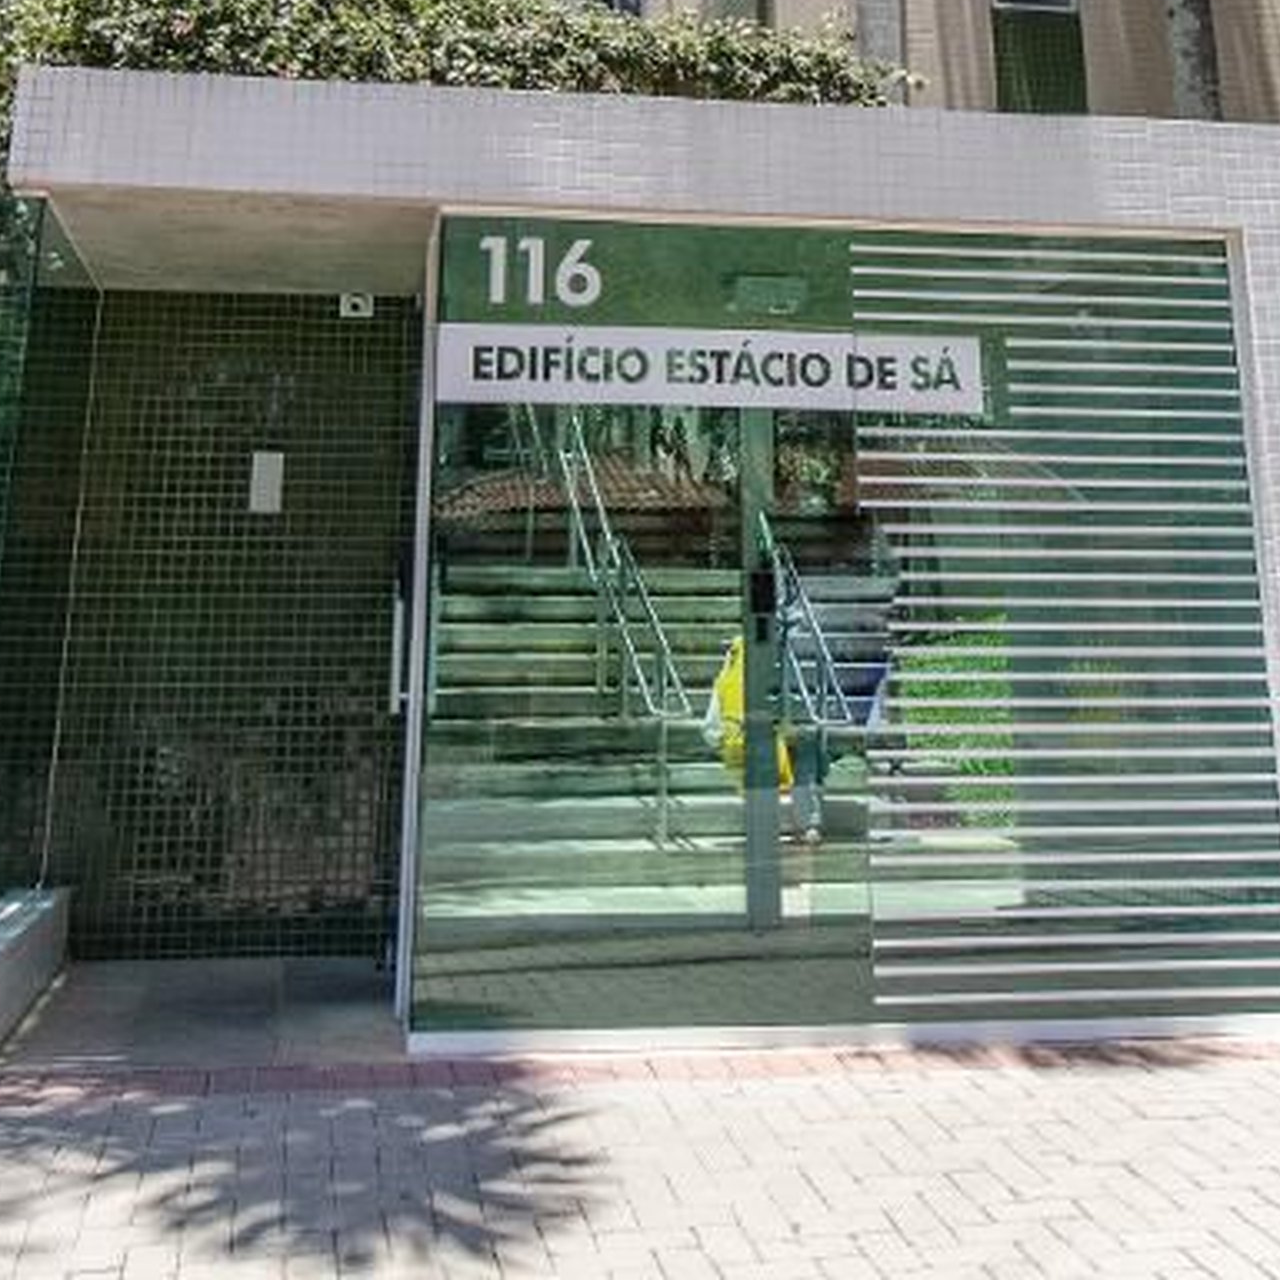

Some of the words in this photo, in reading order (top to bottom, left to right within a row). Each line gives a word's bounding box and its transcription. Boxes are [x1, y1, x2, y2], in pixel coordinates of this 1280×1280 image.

[480, 235, 602, 307] 116
[472, 335, 650, 384] EDIFÍCIO
[666, 339, 831, 388] ESTÁCIO
[846, 352, 898, 389] DE
[910, 345, 961, 391] SÁ
